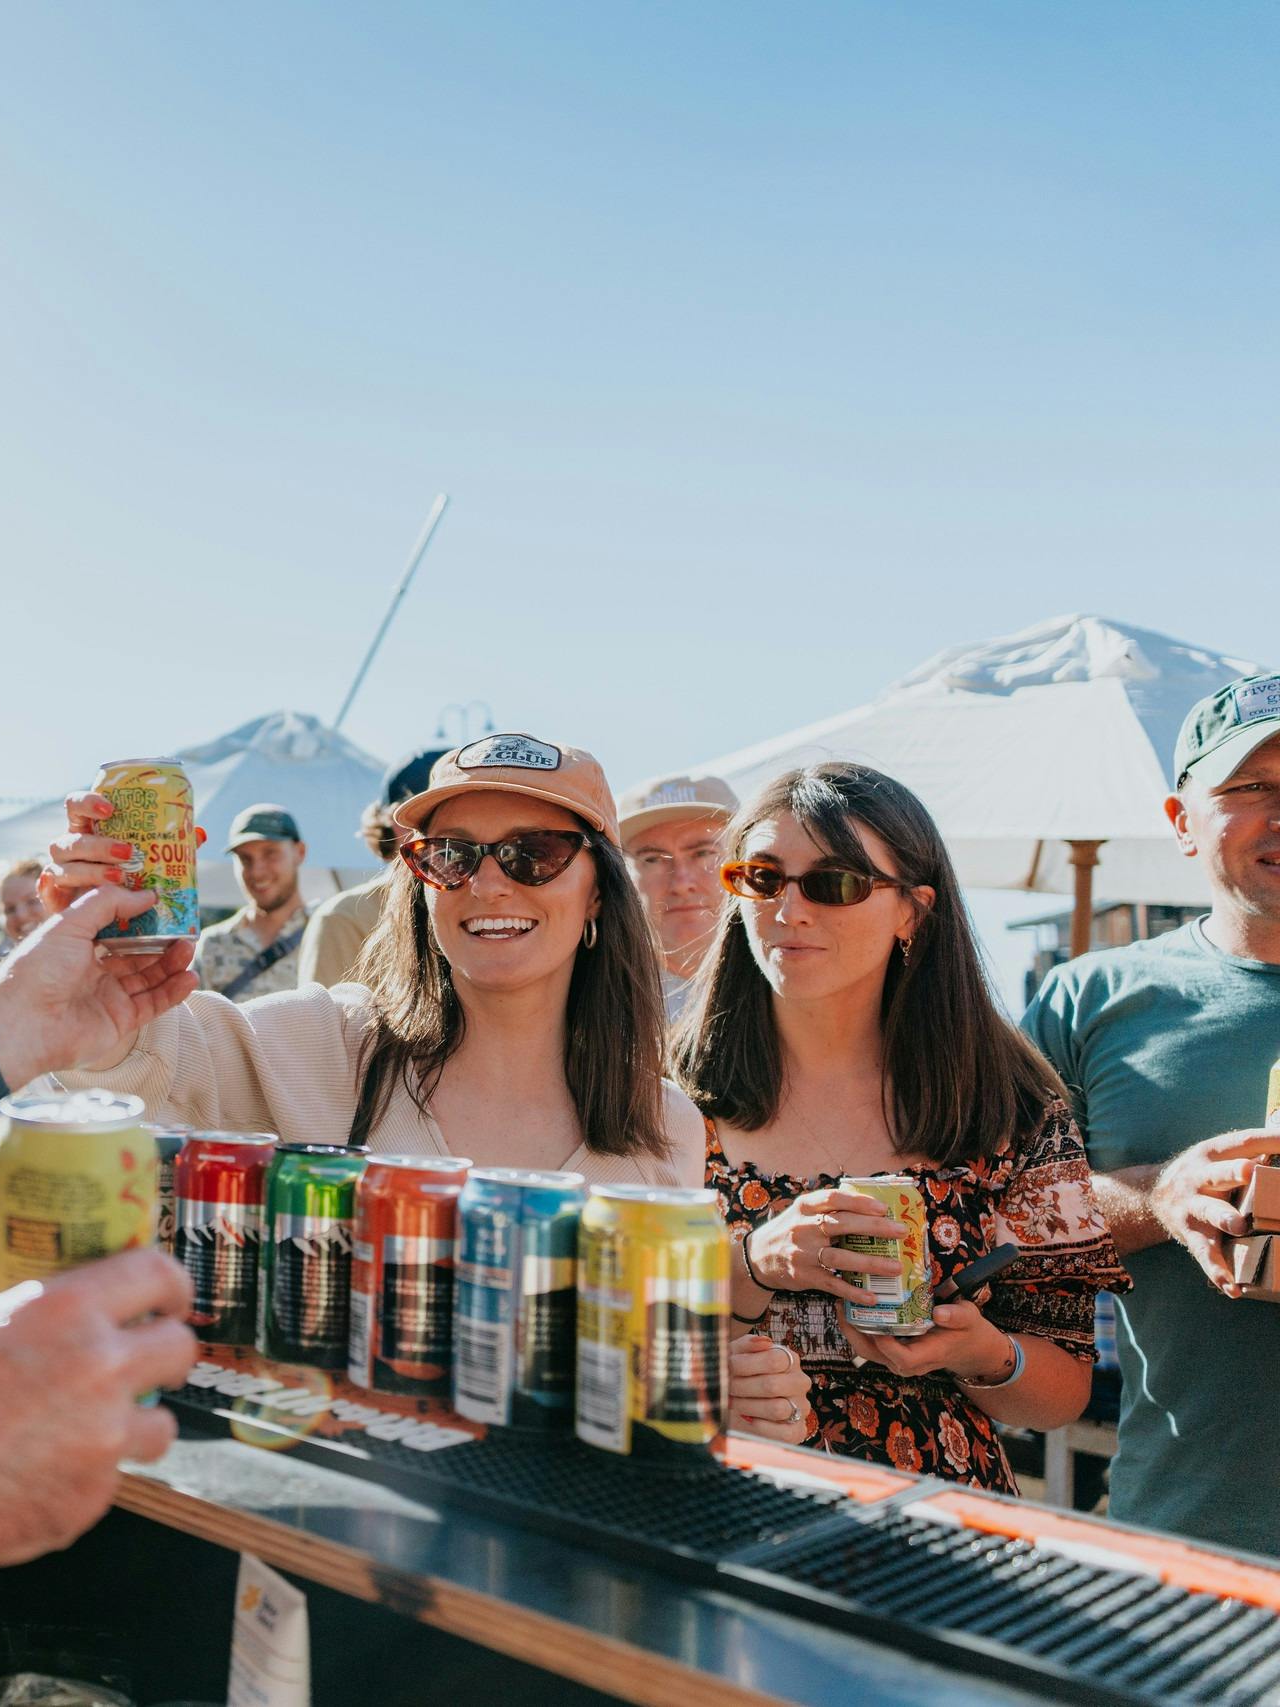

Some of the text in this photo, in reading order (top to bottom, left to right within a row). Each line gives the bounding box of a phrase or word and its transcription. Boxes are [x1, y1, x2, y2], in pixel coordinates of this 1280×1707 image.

[1243, 682, 1280, 697] rive
[495, 751, 553, 766] CLUE
[166, 864, 186, 877] BEER
